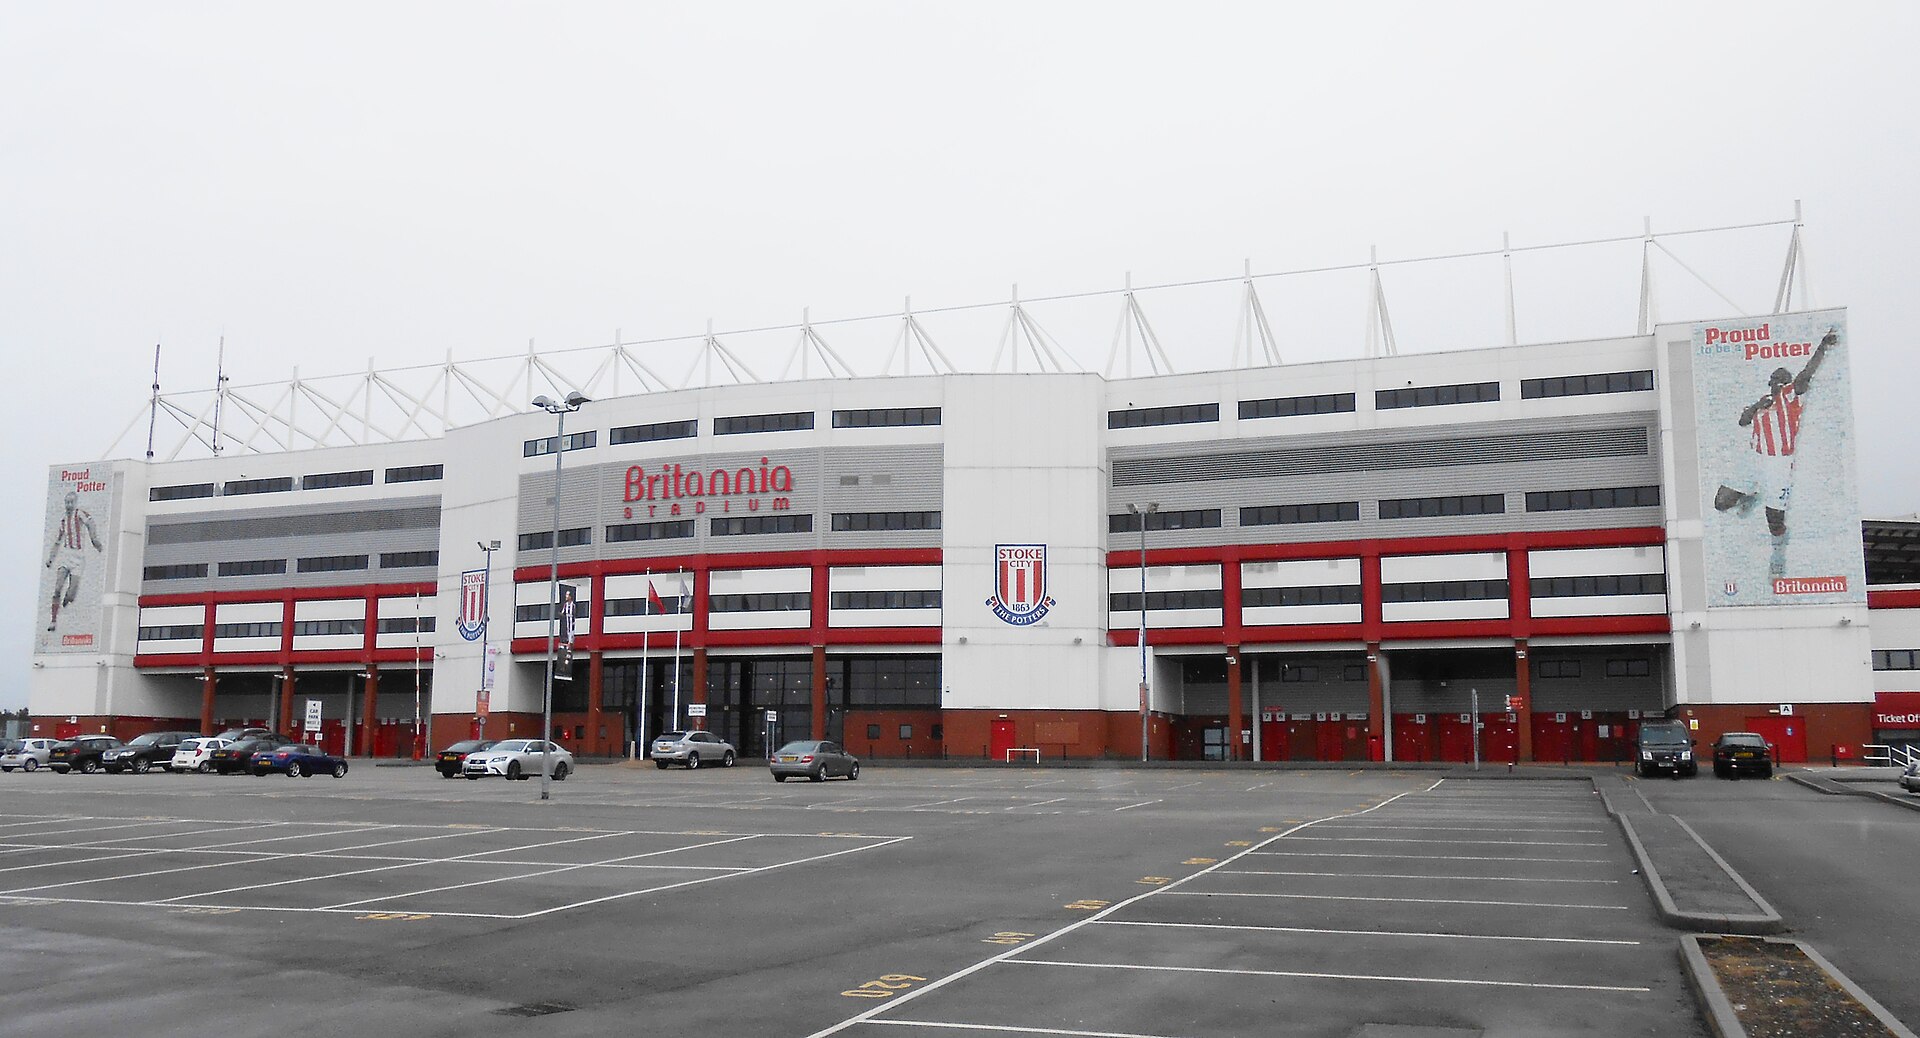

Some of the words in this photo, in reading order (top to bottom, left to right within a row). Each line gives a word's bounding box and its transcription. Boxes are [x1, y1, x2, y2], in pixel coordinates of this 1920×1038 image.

[1705, 323, 1770, 345] Proud
[1744, 342, 1812, 361] Potter
[61, 468, 89, 481] Proud
[623, 456, 793, 502] Britannia
[76, 481, 106, 492] Potter
[623, 497, 790, 519] STADIUM
[999, 548, 1043, 560] STOKE
[1009, 560, 1032, 568] CITY
[464, 574, 485, 584] STOKE
[468, 584, 479, 592] CITY
[1776, 580, 1844, 593] Britannia
[1012, 603, 1030, 612] 1863
[996, 606, 1012, 620] THE
[1011, 606, 1046, 624] POTTERS
[1877, 713, 1906, 723] Ticket
[840, 974, 928, 998] 620
